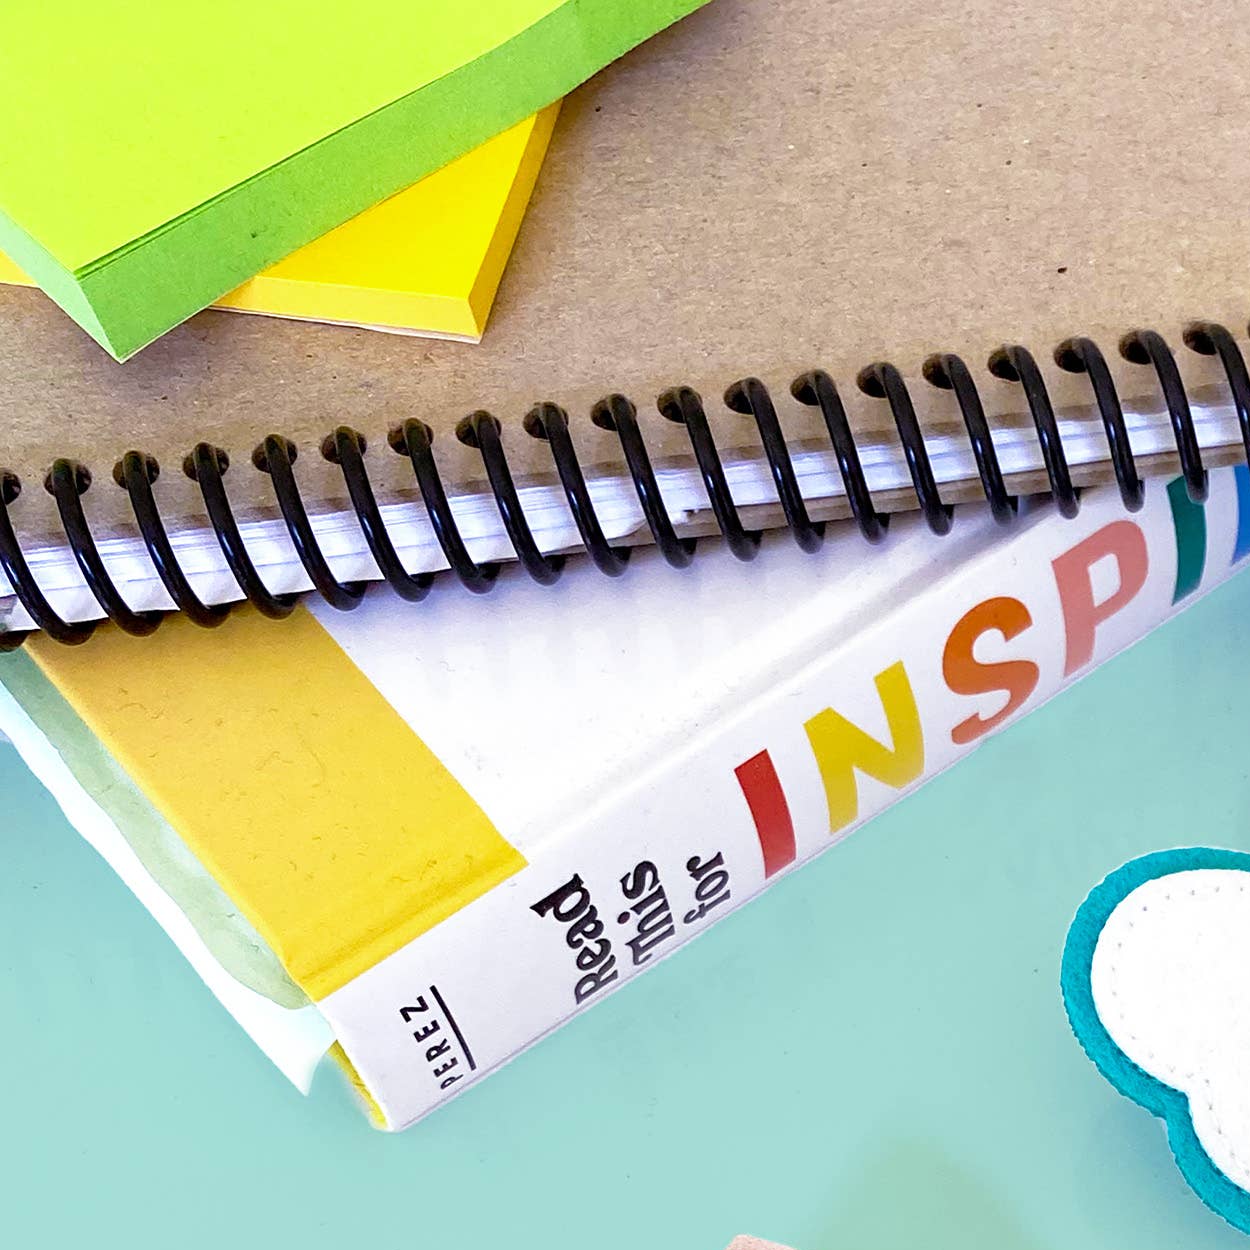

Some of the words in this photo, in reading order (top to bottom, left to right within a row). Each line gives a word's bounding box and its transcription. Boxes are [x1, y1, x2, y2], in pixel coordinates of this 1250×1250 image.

[617, 860, 676, 966] This
[683, 851, 731, 924] for
[530, 873, 618, 1005] Read
[400, 995, 463, 1091] PEREZ
